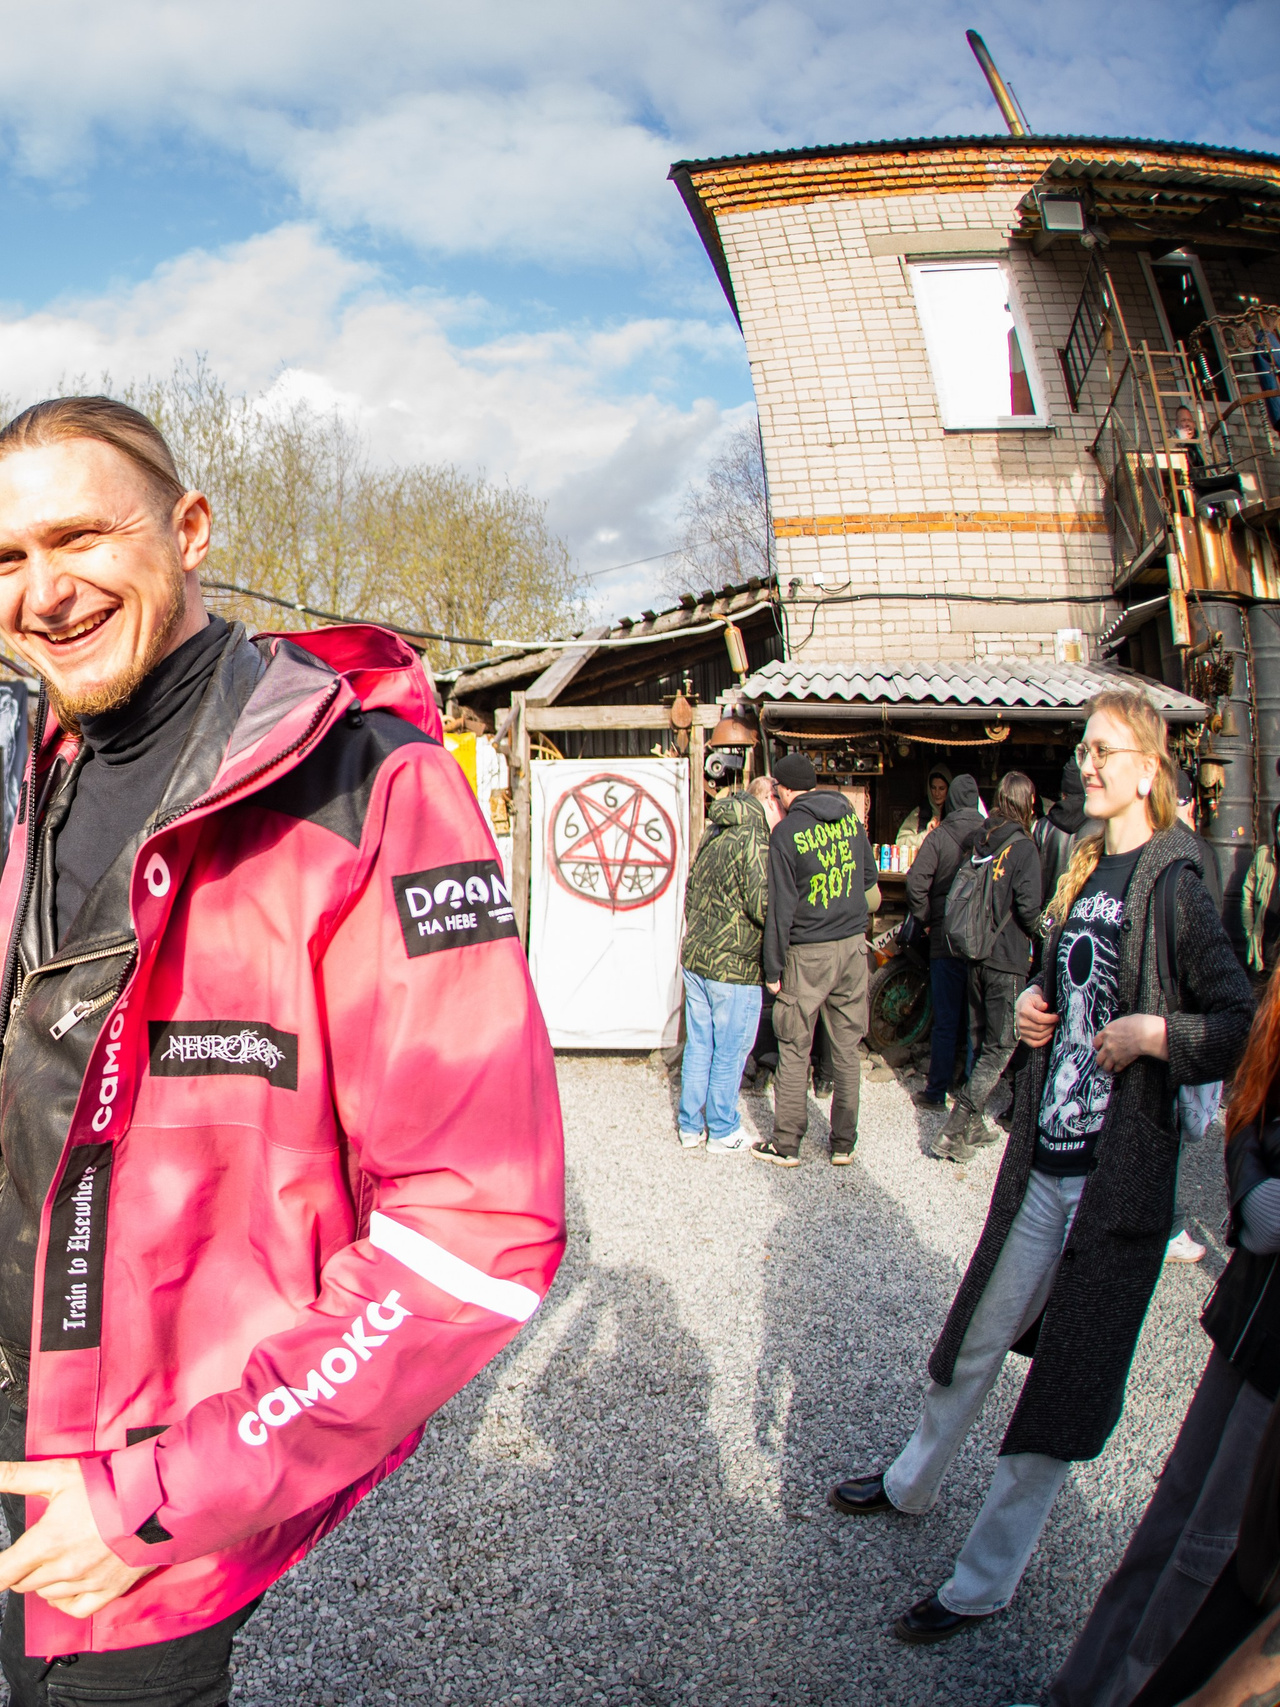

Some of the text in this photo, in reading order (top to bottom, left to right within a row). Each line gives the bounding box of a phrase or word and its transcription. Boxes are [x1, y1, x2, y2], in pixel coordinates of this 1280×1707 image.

[604, 786, 618, 808] 6
[564, 813, 580, 838] 6
[644, 818, 663, 842] 6
[793, 813, 859, 855] SLOWLY
[816, 838, 852, 871] WE
[807, 860, 857, 910] ROT
[417, 918, 444, 937] НА
[444, 912, 478, 931] НЕВЕ
[62, 1164, 98, 1331] Train to Elsewhere
